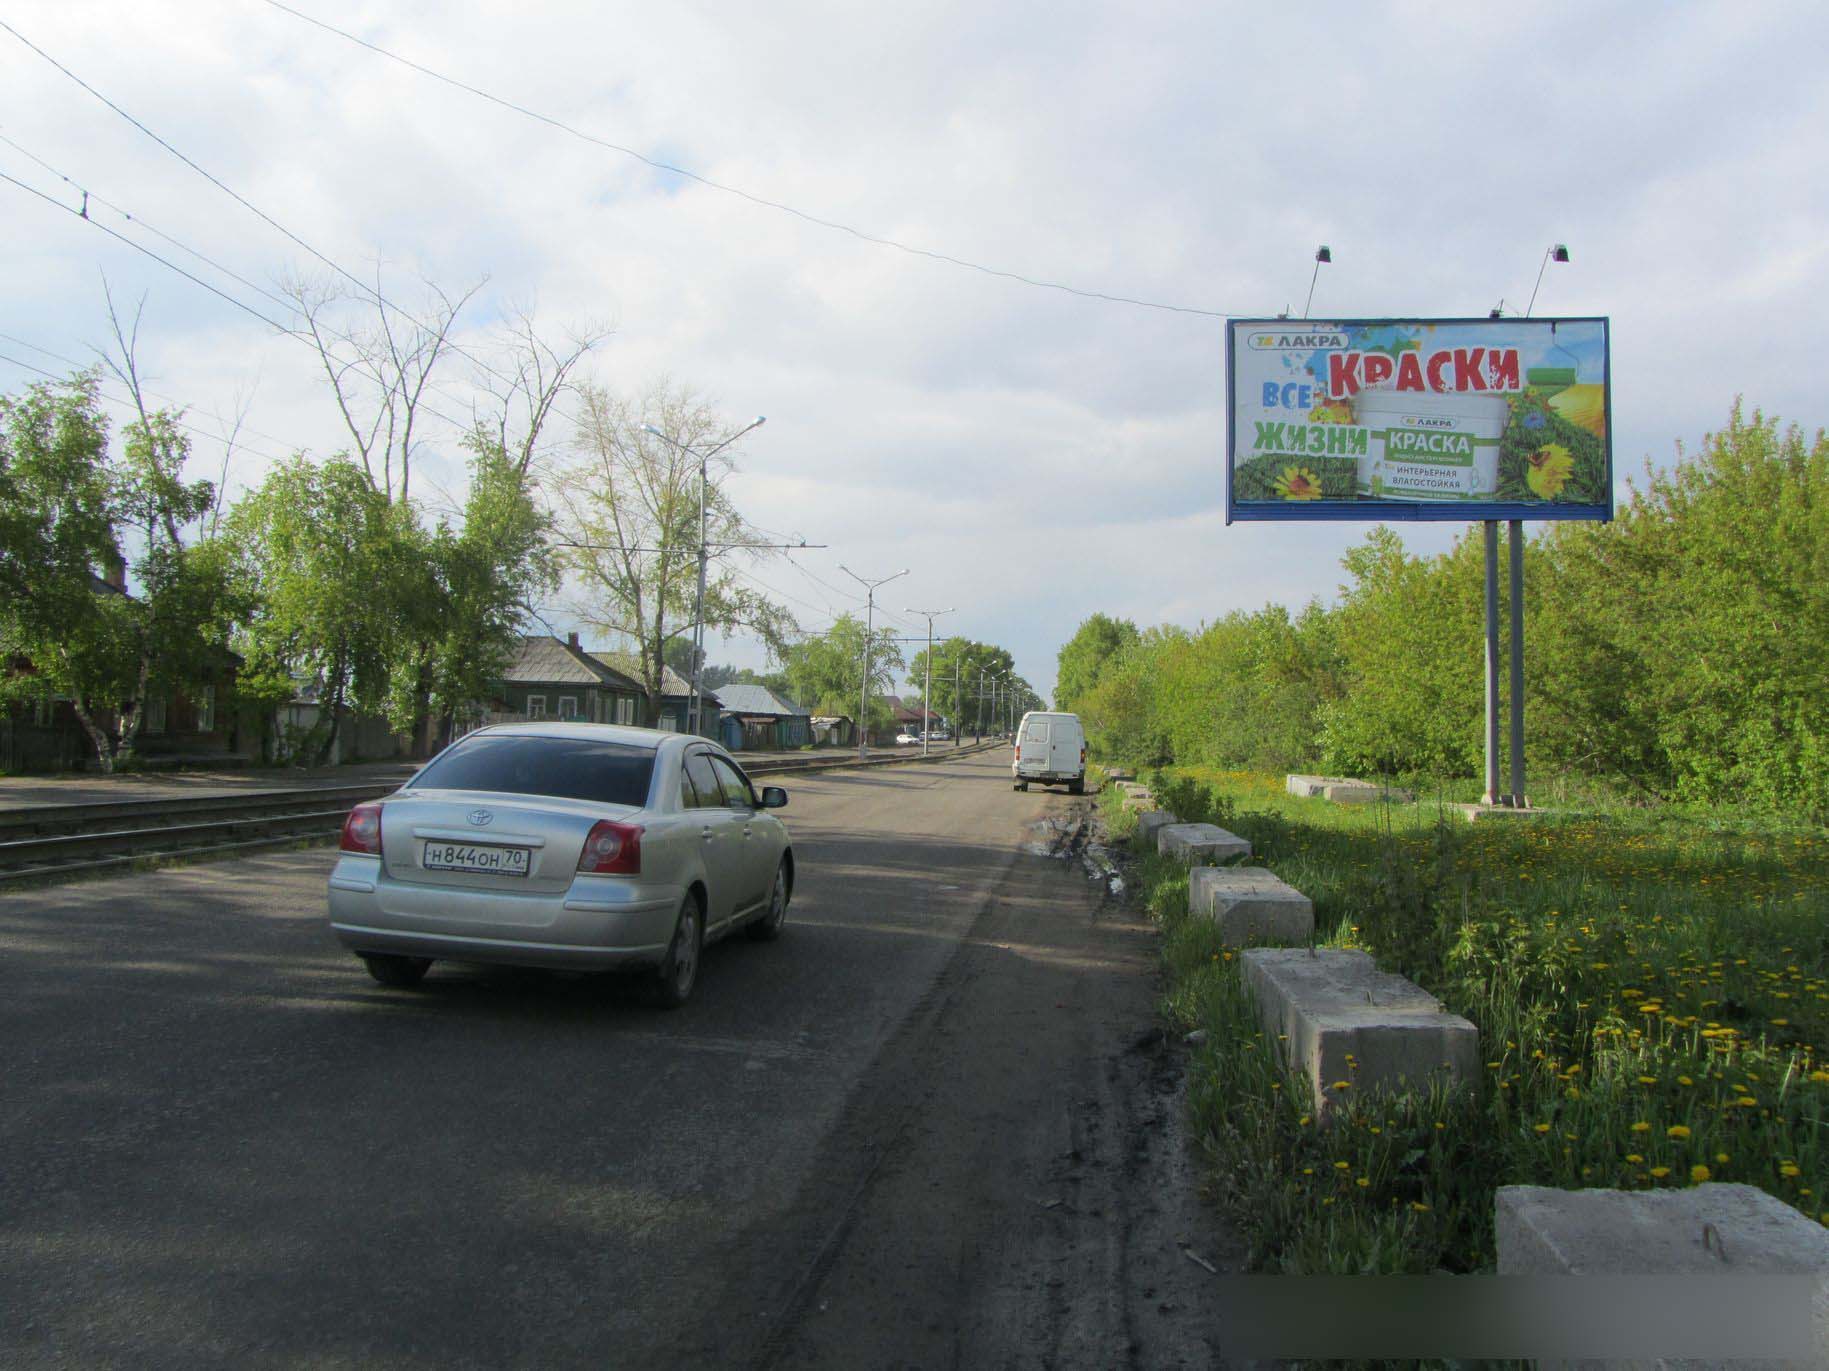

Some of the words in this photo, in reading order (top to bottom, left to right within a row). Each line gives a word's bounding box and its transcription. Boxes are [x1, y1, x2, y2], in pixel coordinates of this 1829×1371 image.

[1279, 335, 1341, 347] ЛАКРА
[1329, 348, 1520, 397] КРАСКИ
[1262, 382, 1312, 409] ВСЕ
[1417, 418, 1452, 427] ЛАКРА
[1254, 421, 1368, 455] ЖИЗНИ
[1390, 431, 1471, 454] КРАСКА
[1396, 466, 1457, 478] ИНТЕРЬЕРНАЯ
[1392, 476, 1461, 489] ВЛАГОСТОЙКАЯ
[504, 849, 522, 864] 70
